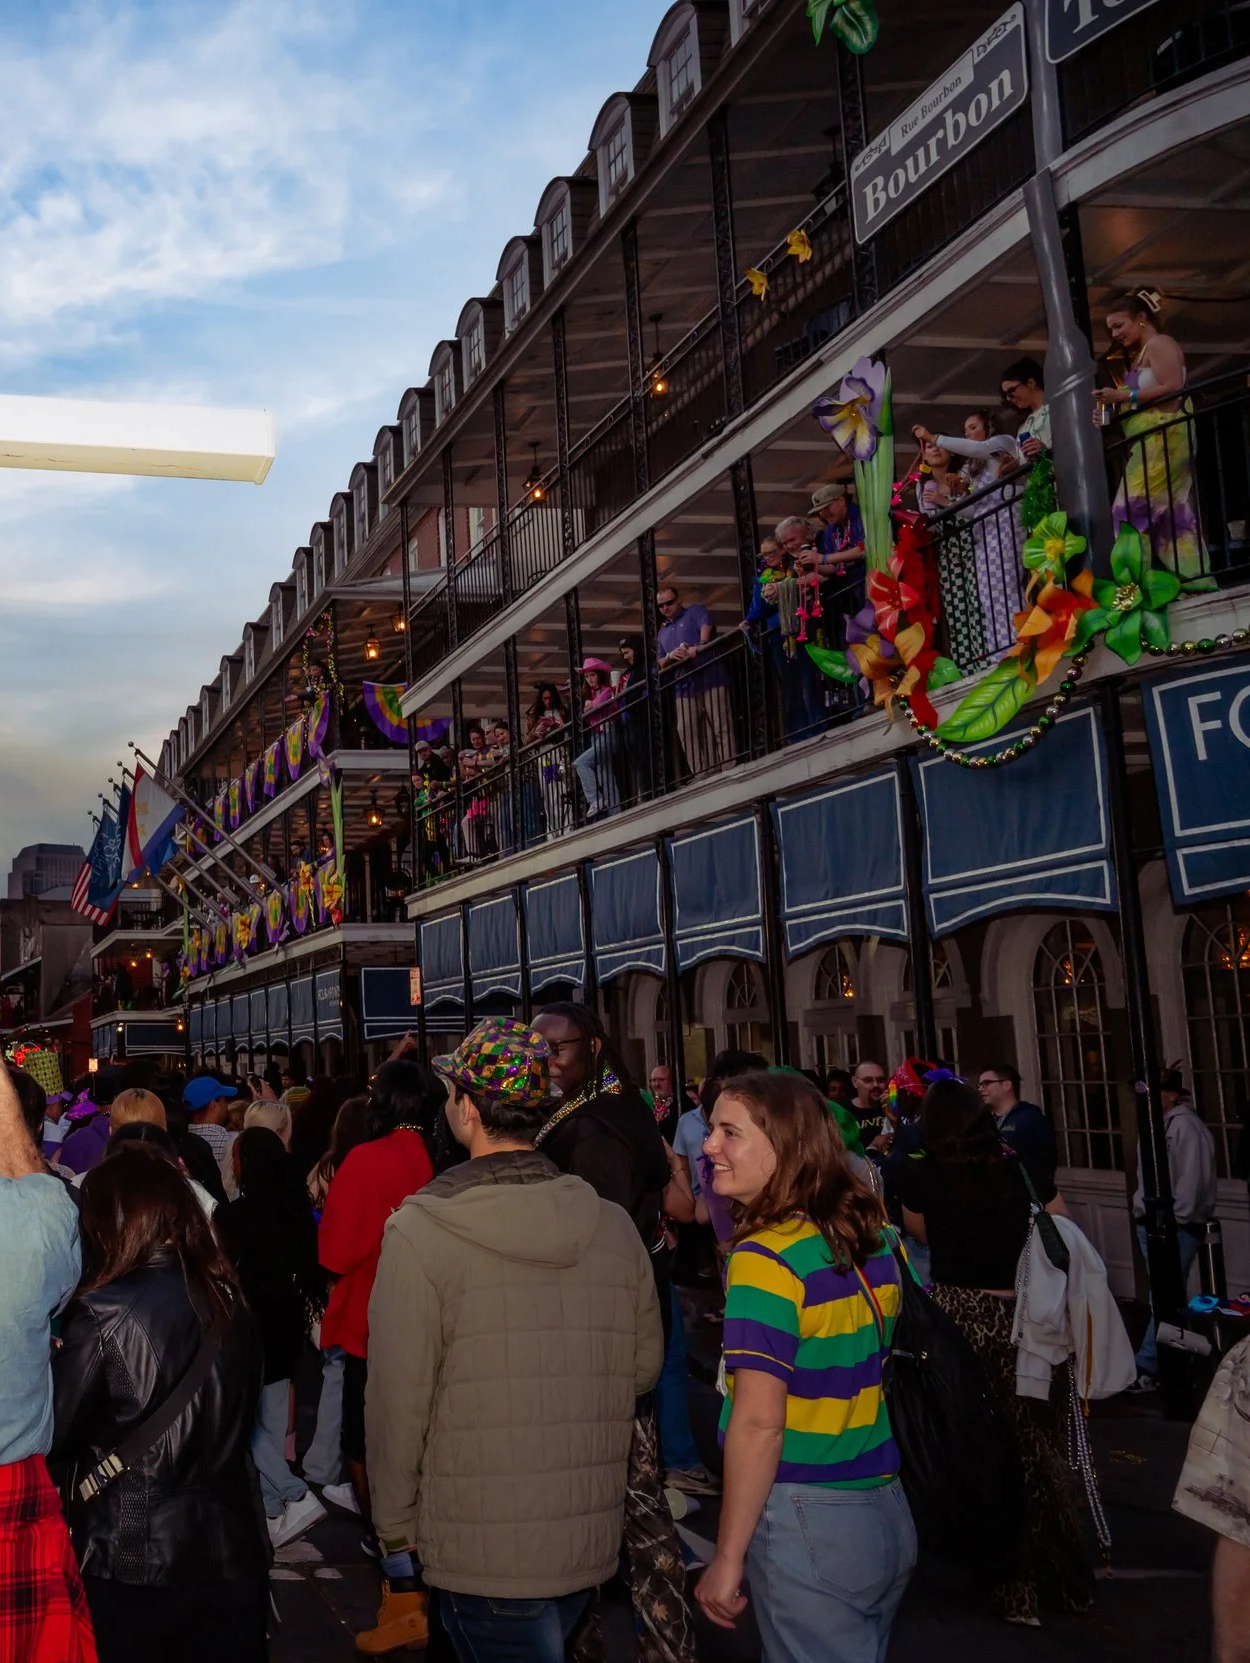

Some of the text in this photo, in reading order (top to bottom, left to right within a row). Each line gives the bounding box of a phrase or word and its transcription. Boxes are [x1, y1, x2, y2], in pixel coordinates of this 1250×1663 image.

[862, 68, 1014, 224] Bourbon
[900, 75, 962, 139] Rue Bourbon
